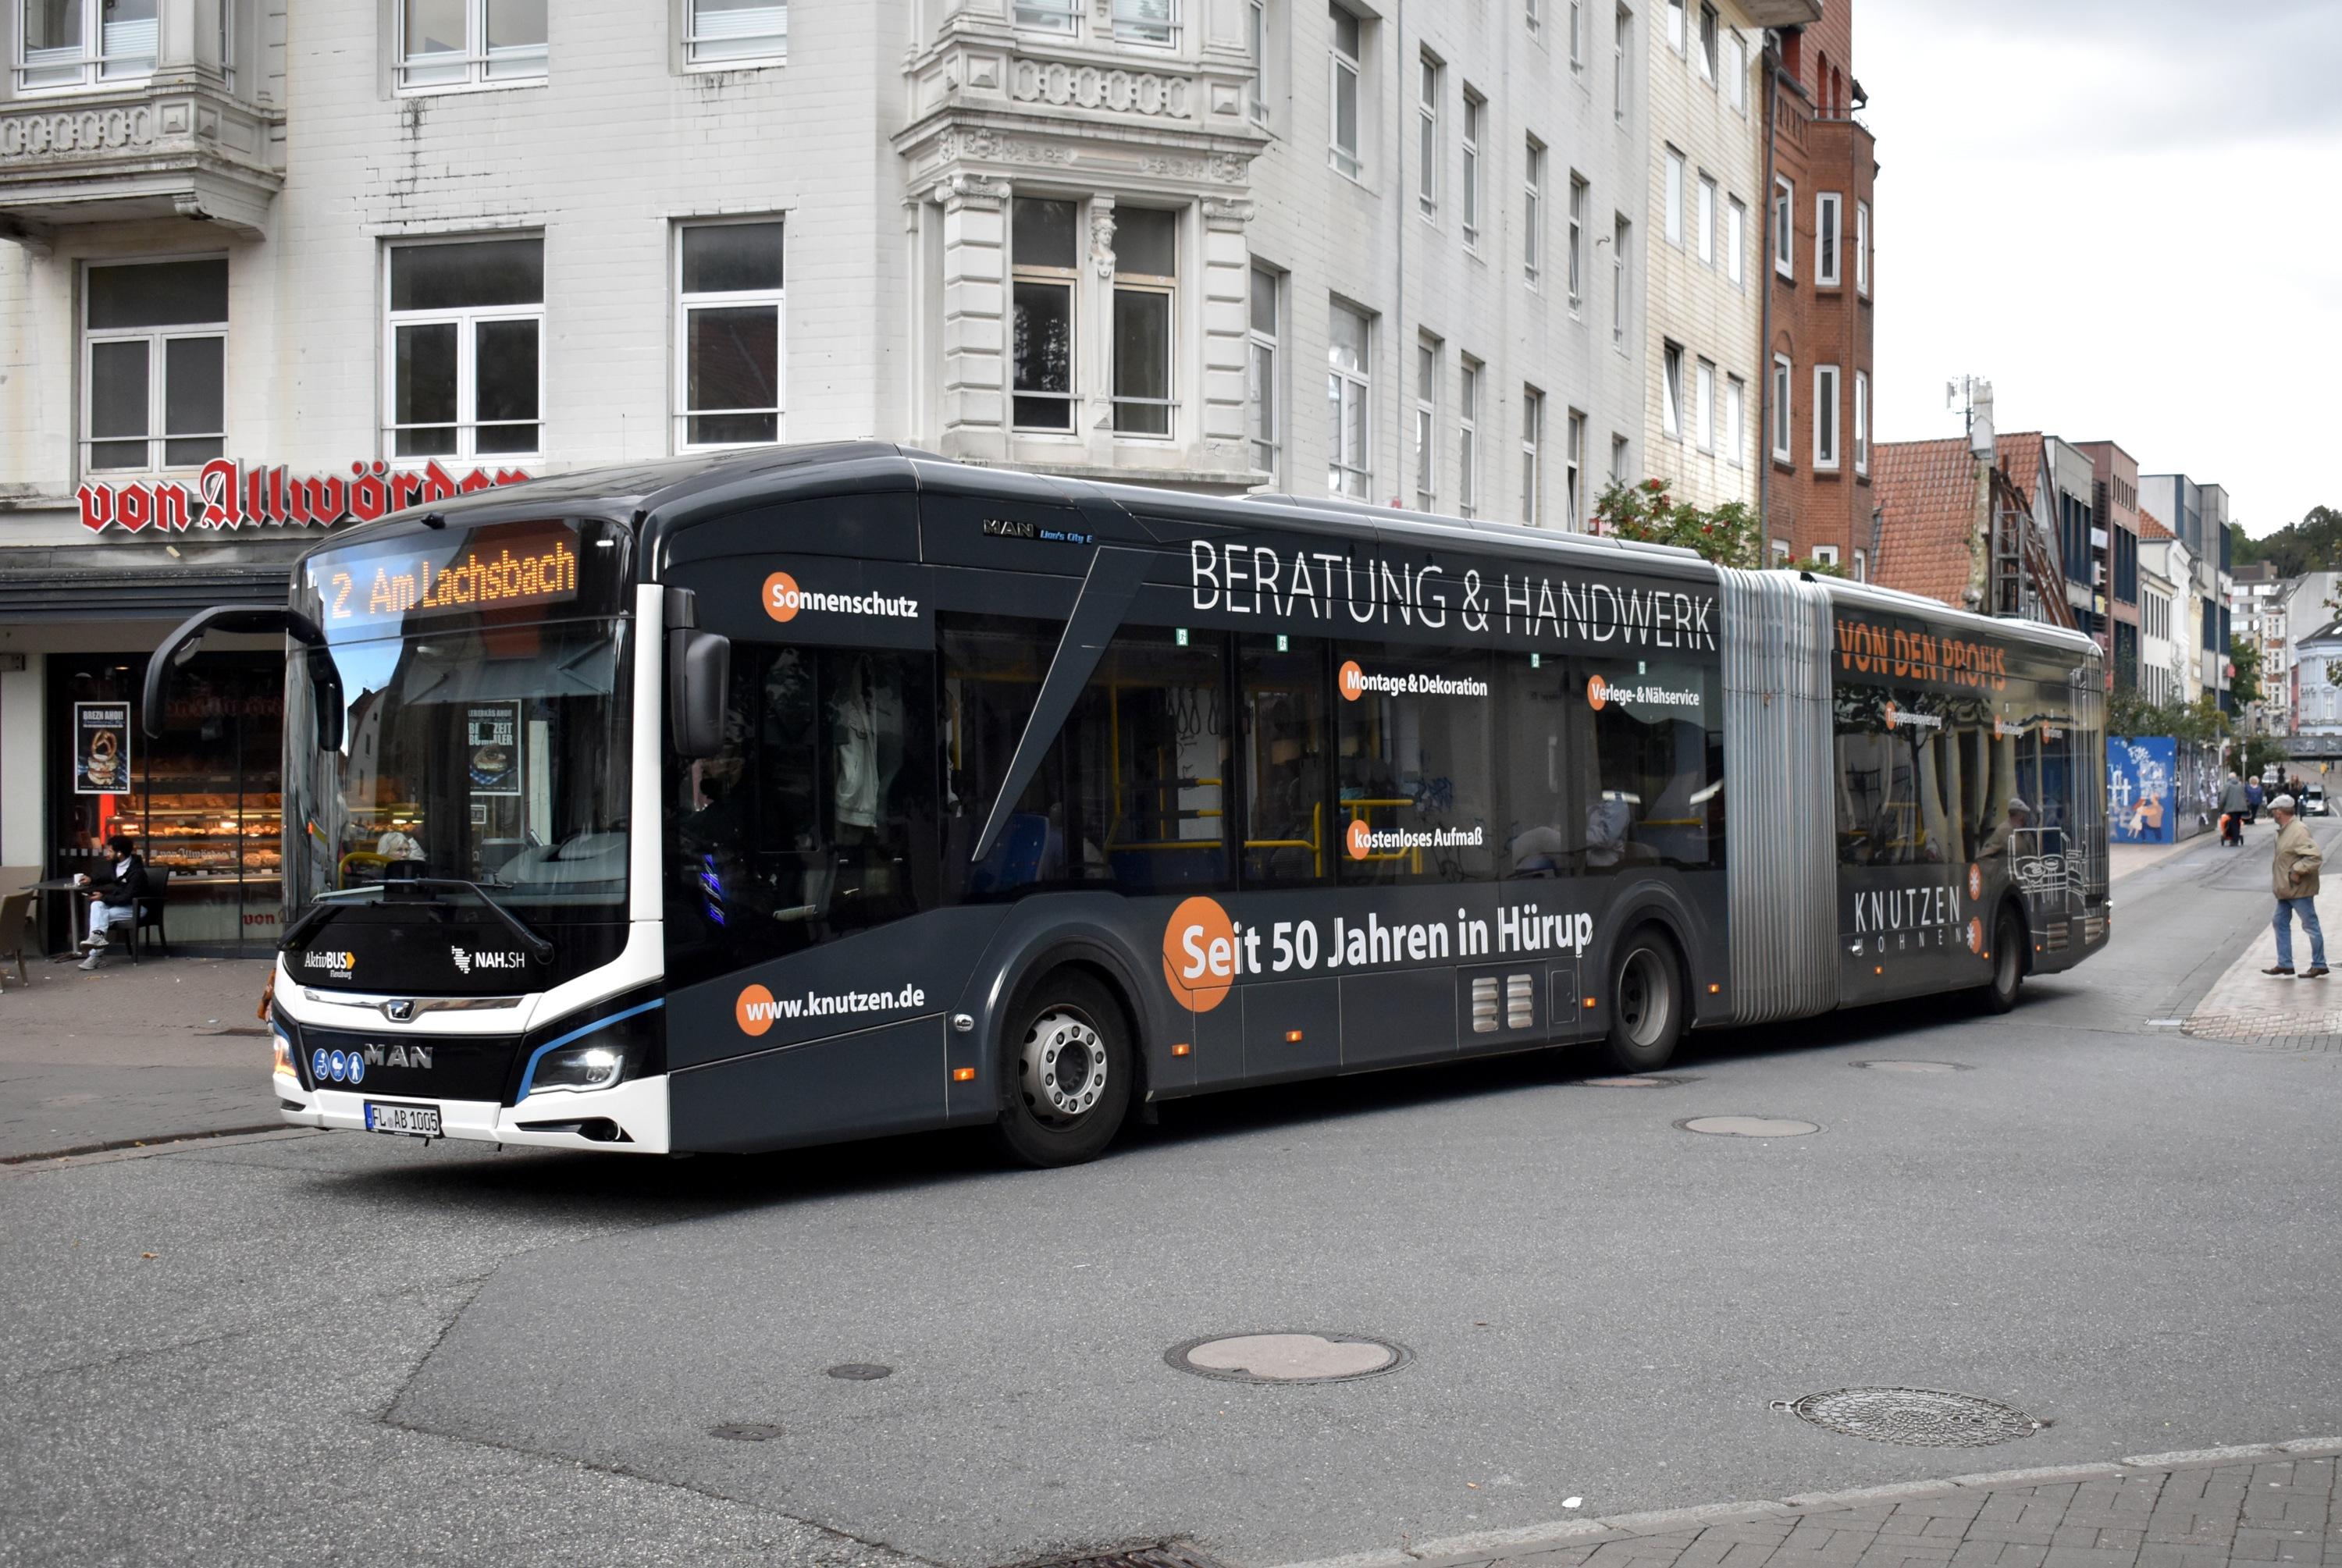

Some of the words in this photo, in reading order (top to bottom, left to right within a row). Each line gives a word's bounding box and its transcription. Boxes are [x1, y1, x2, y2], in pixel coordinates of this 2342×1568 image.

[76, 481, 190, 533] von
[984, 519, 1034, 537] MAN
[1067, 532, 1084, 544] City
[332, 572, 352, 619] 2
[369, 567, 415, 615] Am
[422, 542, 575, 608] Lachsbach
[771, 584, 919, 618] Sonnenschutz
[1191, 540, 1445, 628] BERATUNG
[1462, 569, 1489, 631] &
[1504, 574, 1715, 650] HANDWERK
[1838, 619, 1888, 675] VON
[1894, 630, 1937, 681] DEN
[1942, 638, 2006, 692] PROFIS
[1347, 670, 1406, 696] Montage
[1408, 674, 1418, 693] &
[1419, 674, 1488, 696] Dekoration
[1592, 683, 1635, 706] Verlege-
[1636, 686, 1645, 703] &
[1646, 687, 1700, 706] Nähservice
[1354, 828, 1432, 848] kostenloses
[1433, 827, 1483, 846] Aufmaß
[243, 912, 276, 926] von
[1855, 885, 1960, 933] KNUTZEN
[1183, 921, 1262, 979] Seit
[1272, 919, 1319, 972] 50
[1328, 912, 1449, 968] Jahren
[1458, 908, 1490, 956] in
[1497, 903, 1594, 958] Hürup
[304, 951, 347, 969] AktivBUS
[475, 951, 525, 969] NAH.SH
[746, 983, 925, 1021] www.knutzen.de
[364, 1044, 434, 1069] MAN
[372, 1107, 386, 1127] FL
[394, 1109, 407, 1129] AB
[410, 1111, 438, 1132] 1005
